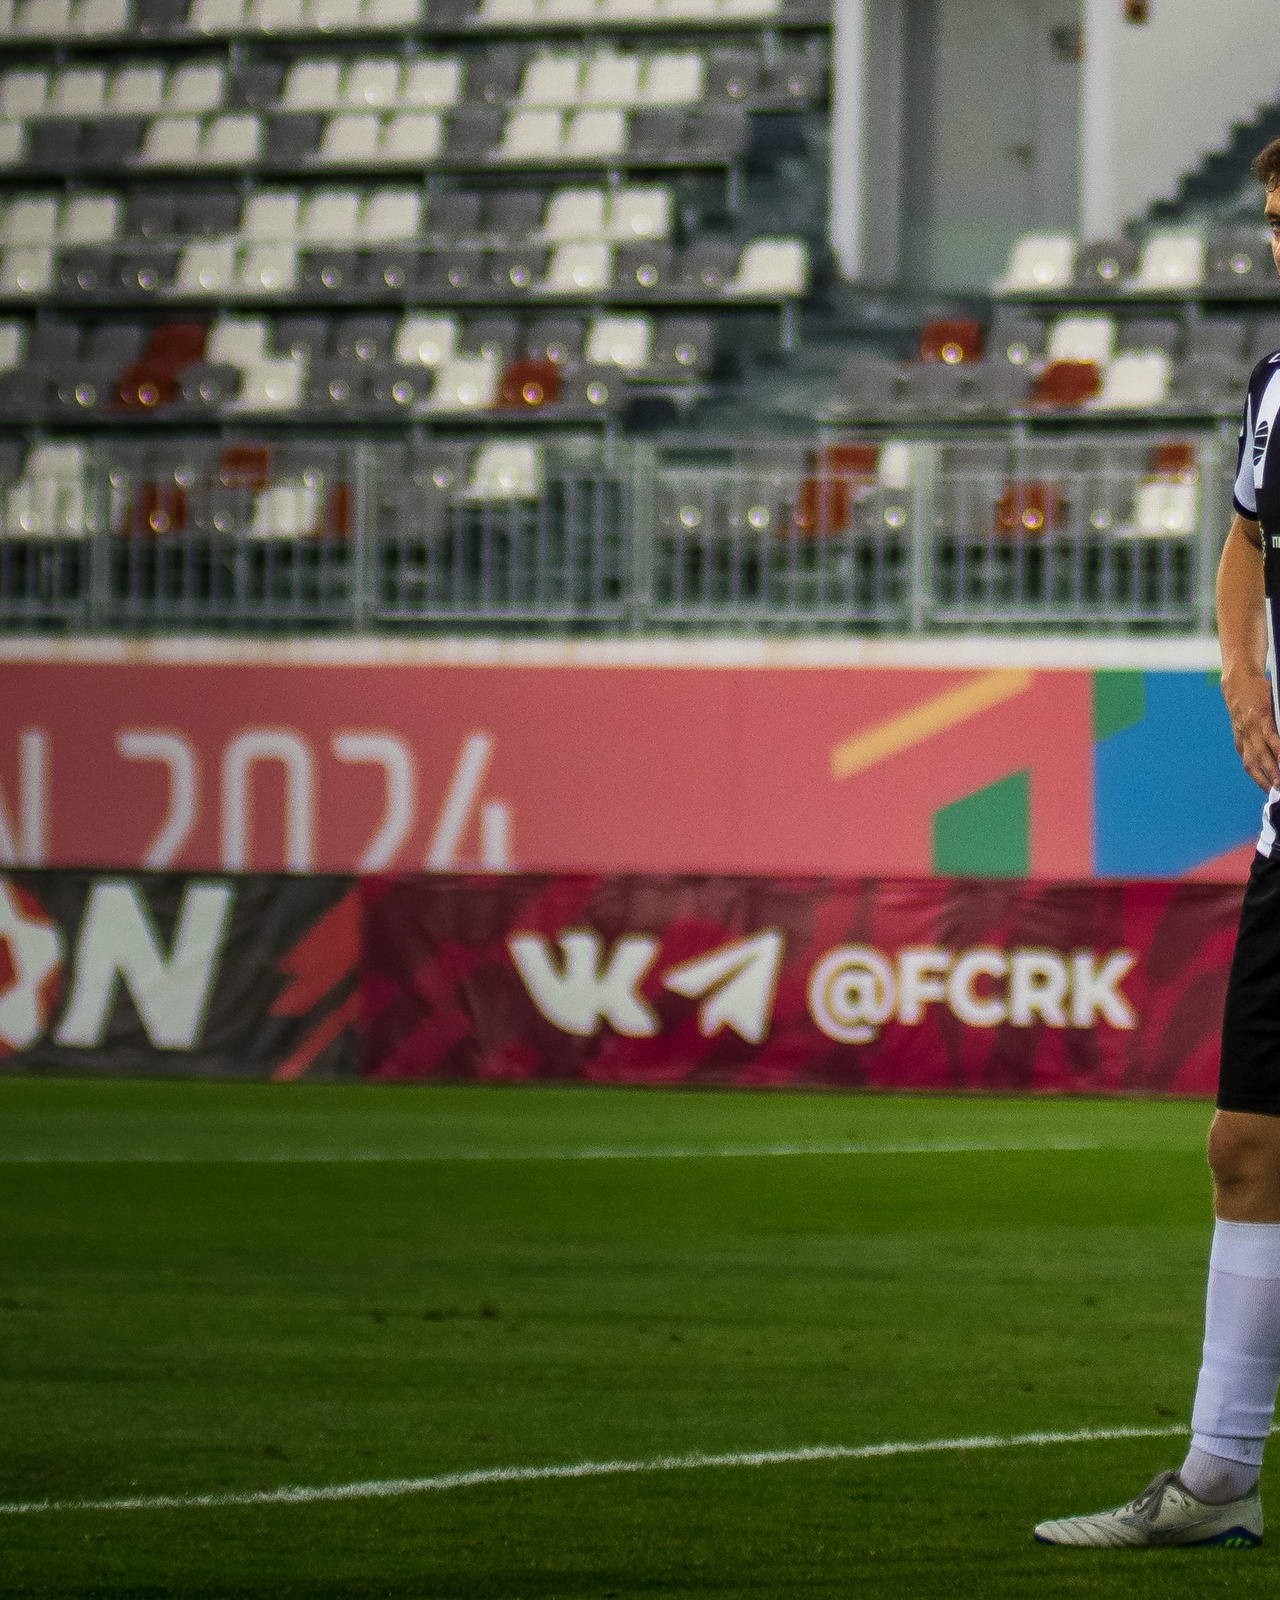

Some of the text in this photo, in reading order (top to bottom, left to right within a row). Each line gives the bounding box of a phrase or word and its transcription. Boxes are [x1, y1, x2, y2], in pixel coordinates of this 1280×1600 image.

[115, 728, 513, 874] 2024
[507, 930, 1138, 1045] VK @FCRK
